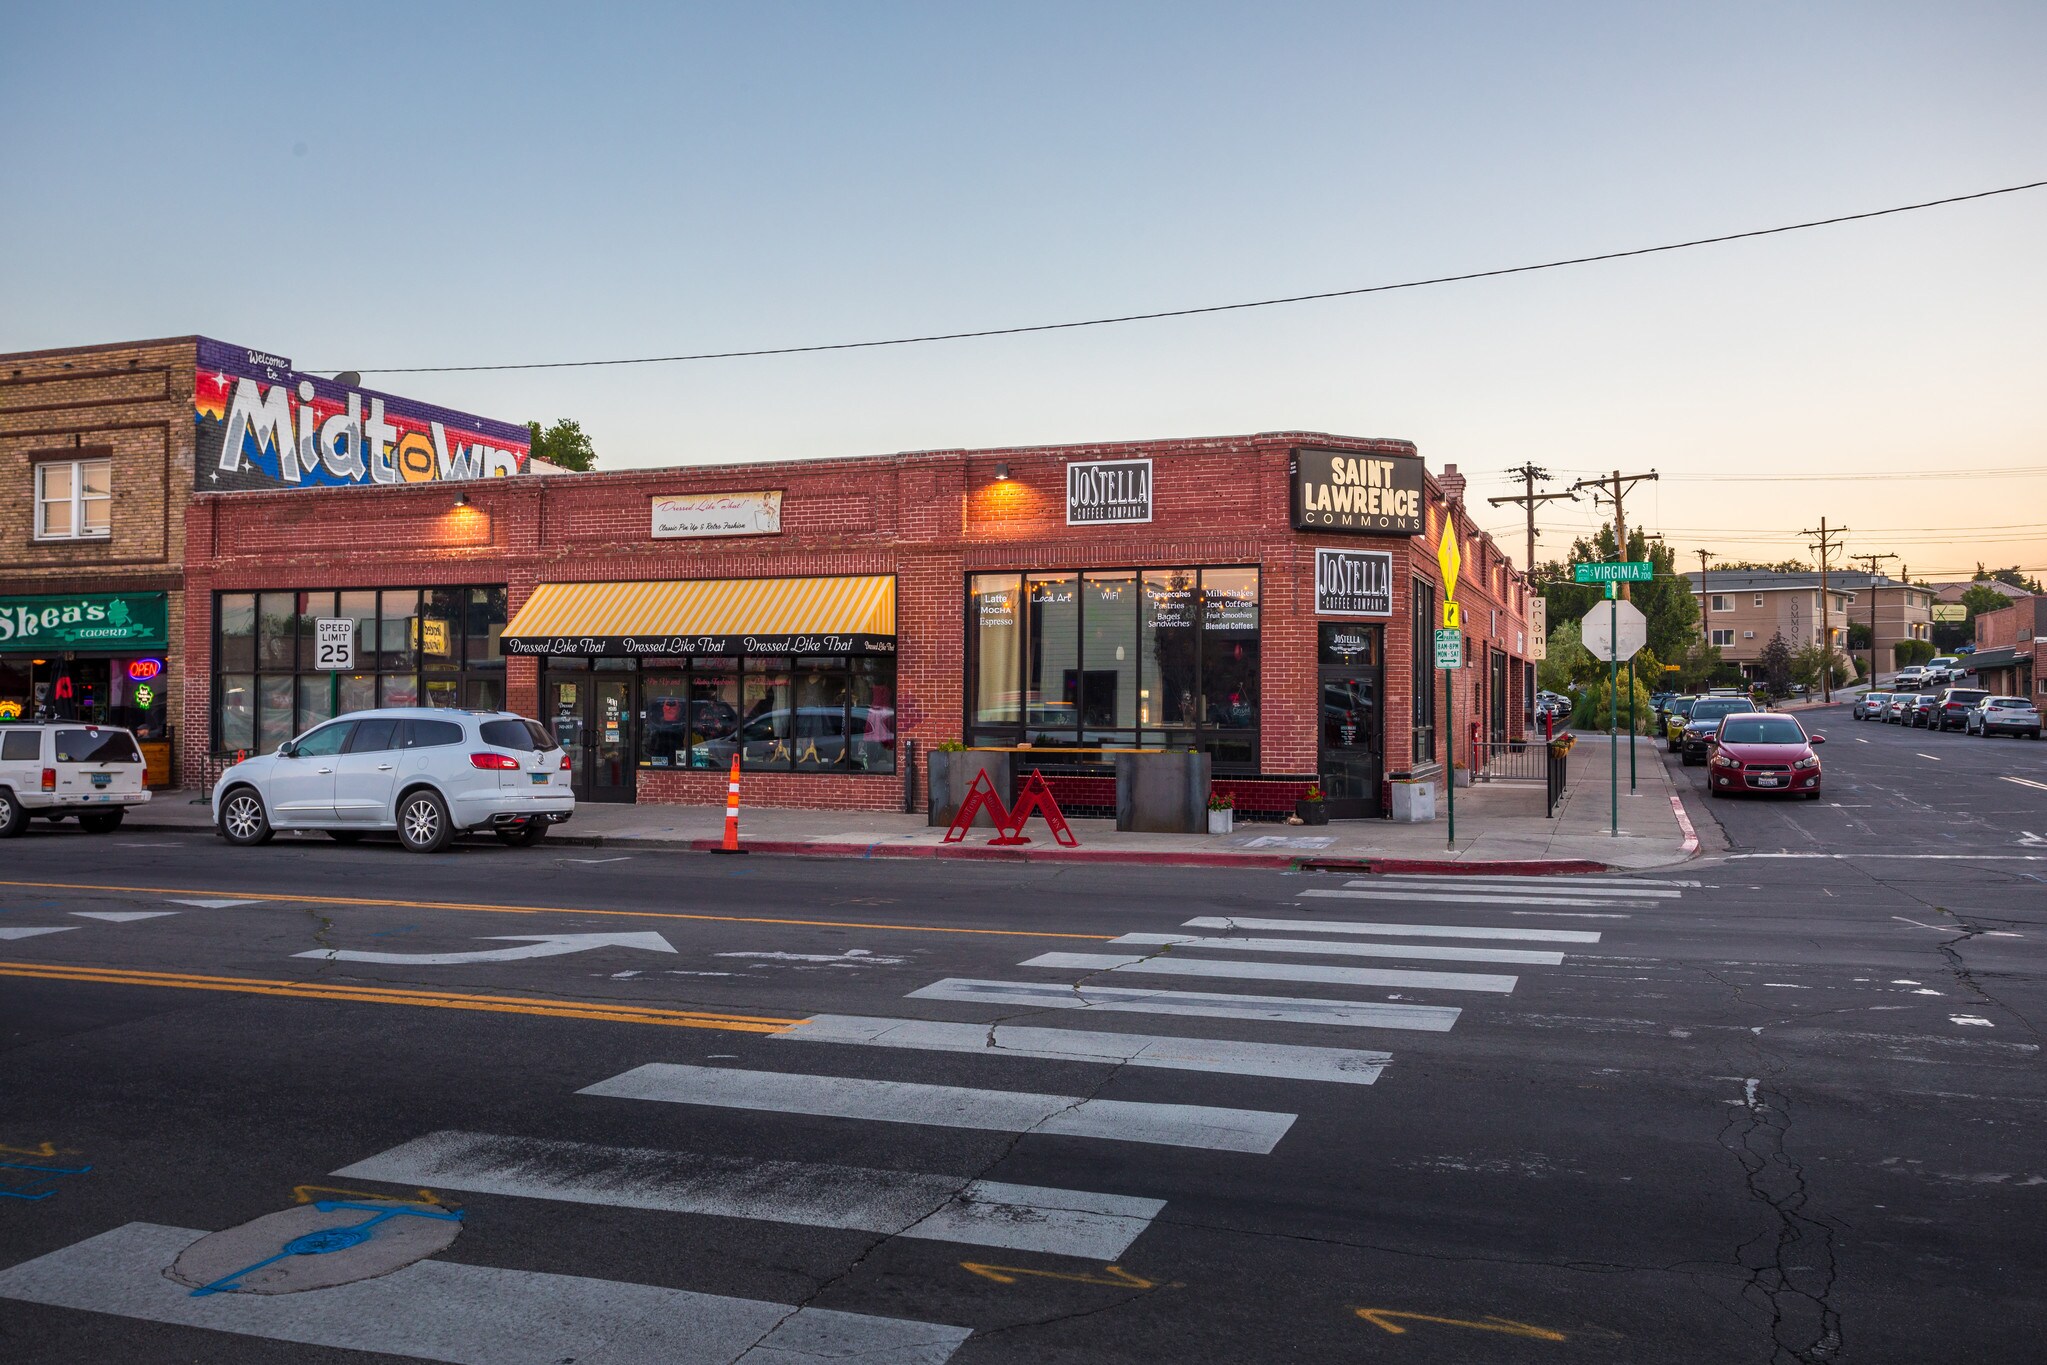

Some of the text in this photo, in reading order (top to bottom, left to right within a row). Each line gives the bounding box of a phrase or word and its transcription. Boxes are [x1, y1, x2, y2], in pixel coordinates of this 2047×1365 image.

[247, 350, 288, 368] Welcome
[1331, 456, 1394, 488] SAINT
[1305, 482, 1420, 517] LAWRENCE
[696, 499, 716, 512] Like
[1077, 505, 1141, 519] COFFEE COMPANY
[1305, 512, 1420, 529] COMMONS
[658, 524, 678, 532] Classic
[678, 523, 688, 531] Pin
[688, 522, 699, 532] Up
[706, 522, 721, 531] Retro
[723, 521, 746, 530] Fashion
[1590, 565, 1639, 579] S VIRGINIA
[1642, 563, 1649, 571] ST
[1032, 593, 1071, 602] Local Art
[1147, 590, 1191, 598] Cheesecakes
[1226, 589, 1254, 597] Shakes
[985, 594, 1008, 603] Latte
[1325, 597, 1383, 610] COFFEE COMPANY
[1153, 601, 1185, 609] Pastries
[1225, 600, 1252, 608] Coffees
[980, 606, 1012, 614] MOCHA
[1221, 611, 1252, 619] Smoothies
[0, 600, 106, 641] Shea's
[980, 617, 1013, 627] Espresso
[1157, 613, 1181, 621] Bagels
[1790, 596, 1799, 648] COMMONS
[319, 623, 351, 632] SPEED
[1205, 622, 1254, 630] Blended Coffees
[80, 628, 128, 638] tavern
[322, 633, 347, 642] LIMIT
[1436, 631, 1443, 640] 2
[509, 638, 605, 654] Dressed Like That
[623, 637, 725, 653] Dressed Like That
[743, 636, 852, 652] Dressed Like That
[864, 641, 878, 650] Dressed
[320, 644, 349, 662] 25
[130, 661, 158, 677] OPEN
